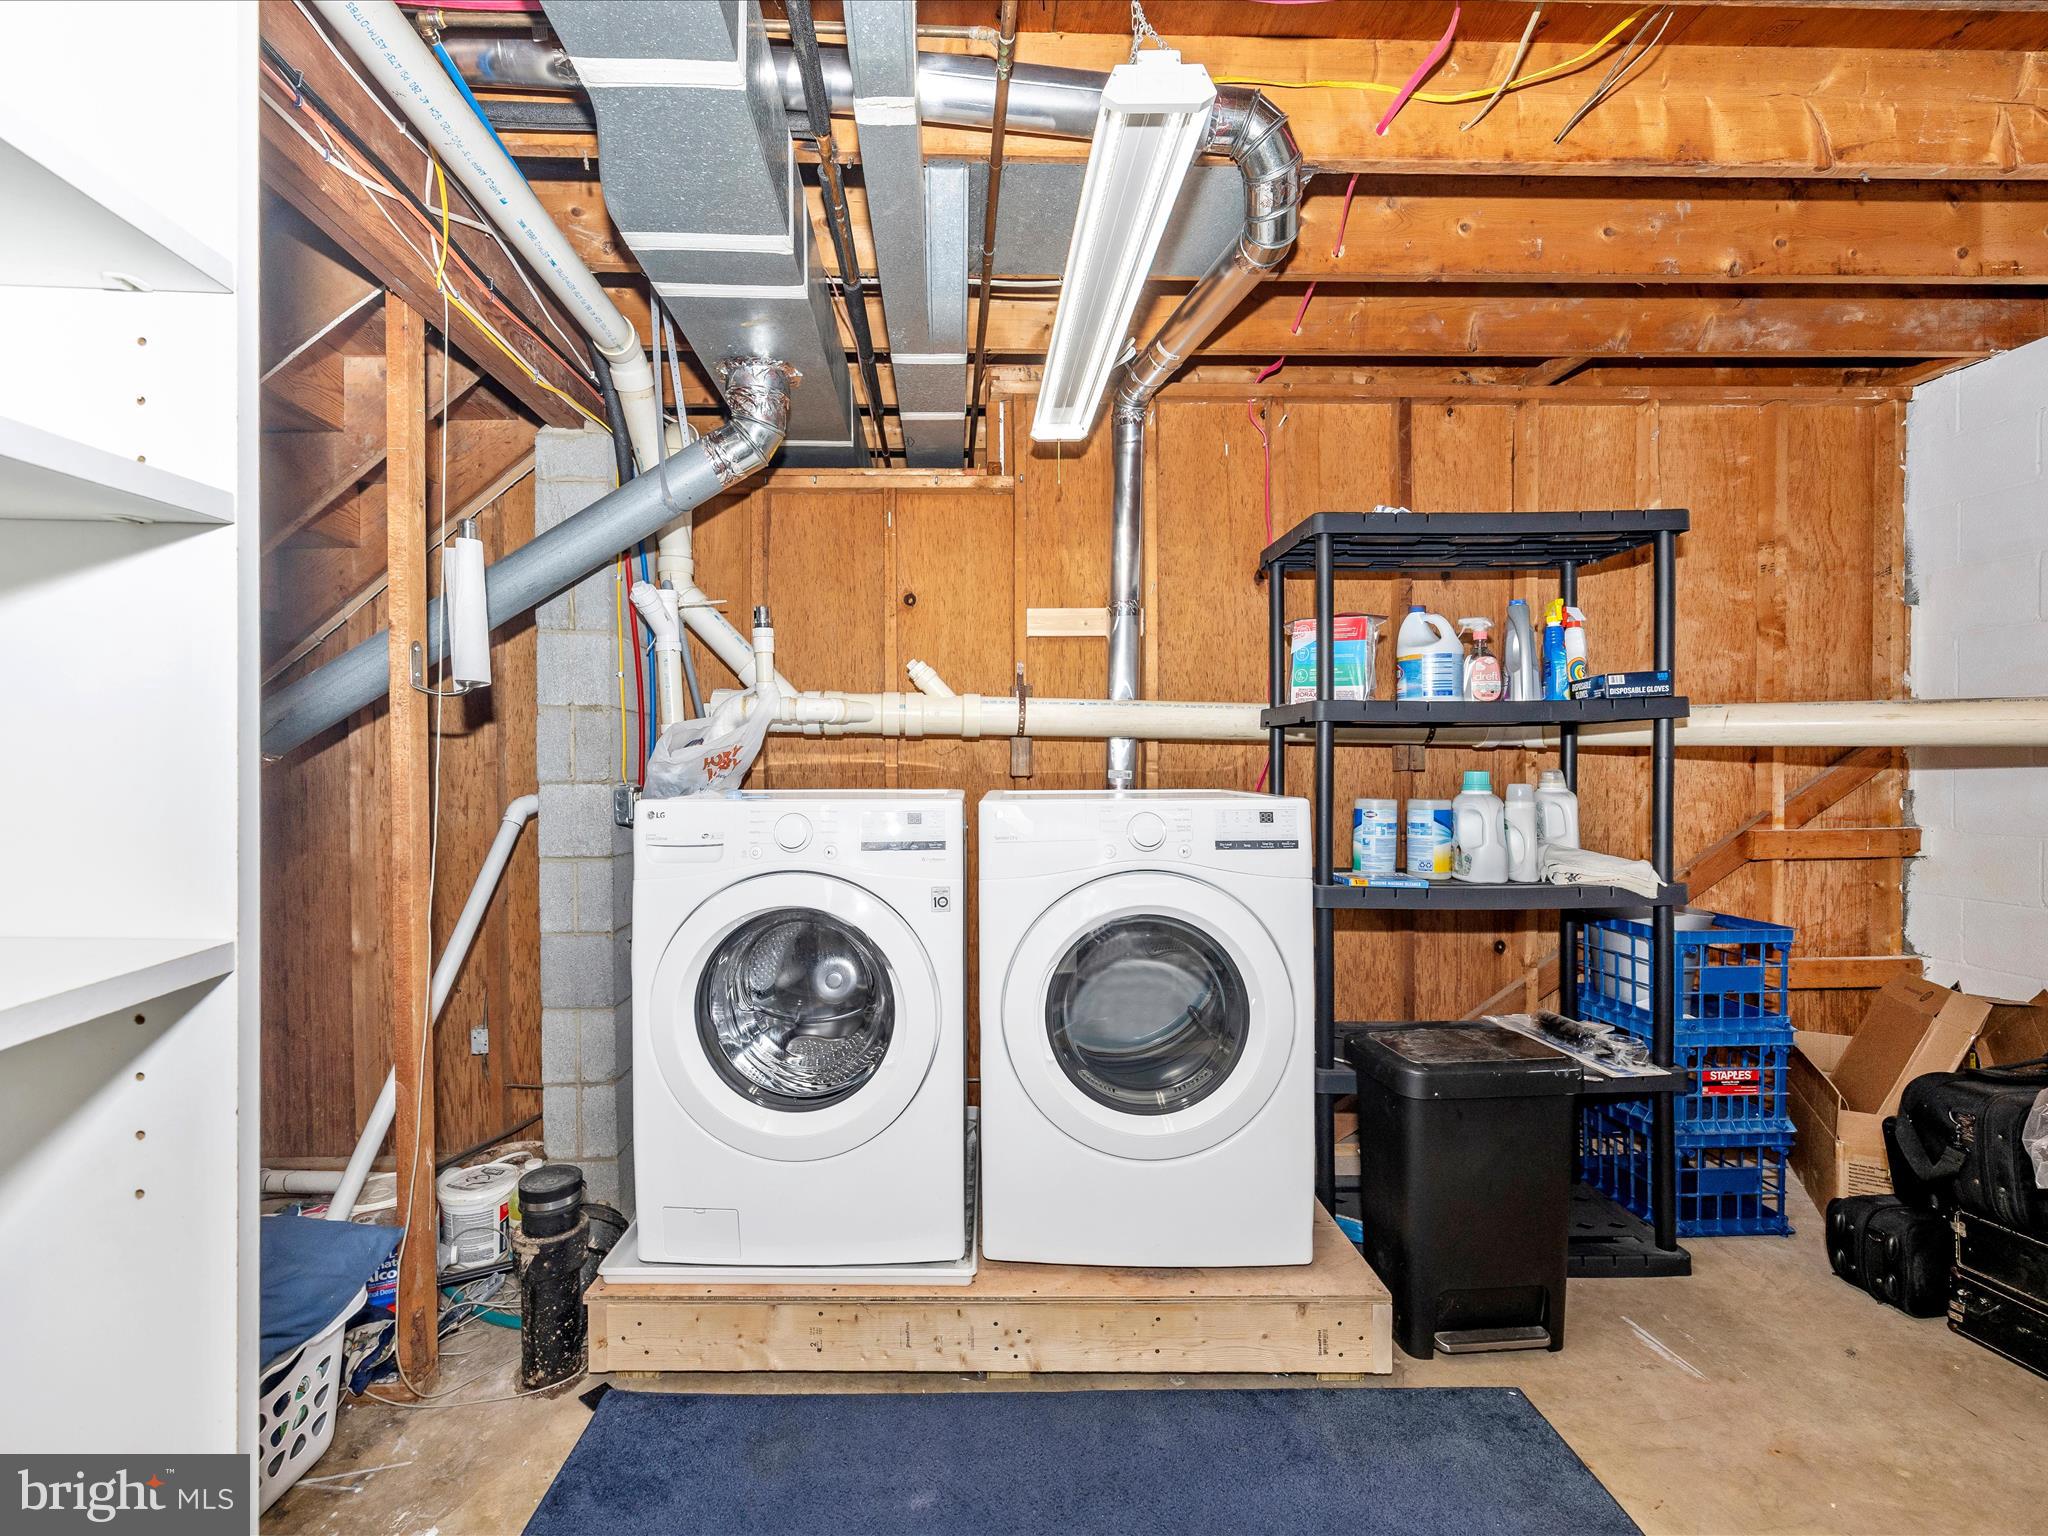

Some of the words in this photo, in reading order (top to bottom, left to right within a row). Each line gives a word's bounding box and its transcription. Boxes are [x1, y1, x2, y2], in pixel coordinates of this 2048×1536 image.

[1474, 671, 1499, 681] dreft
[1609, 686, 1646, 695] DISPOSABLE
[1646, 684, 1670, 693] GLOVES
[655, 811, 666, 819] LG
[1710, 1070, 1752, 1081] STAPLES
